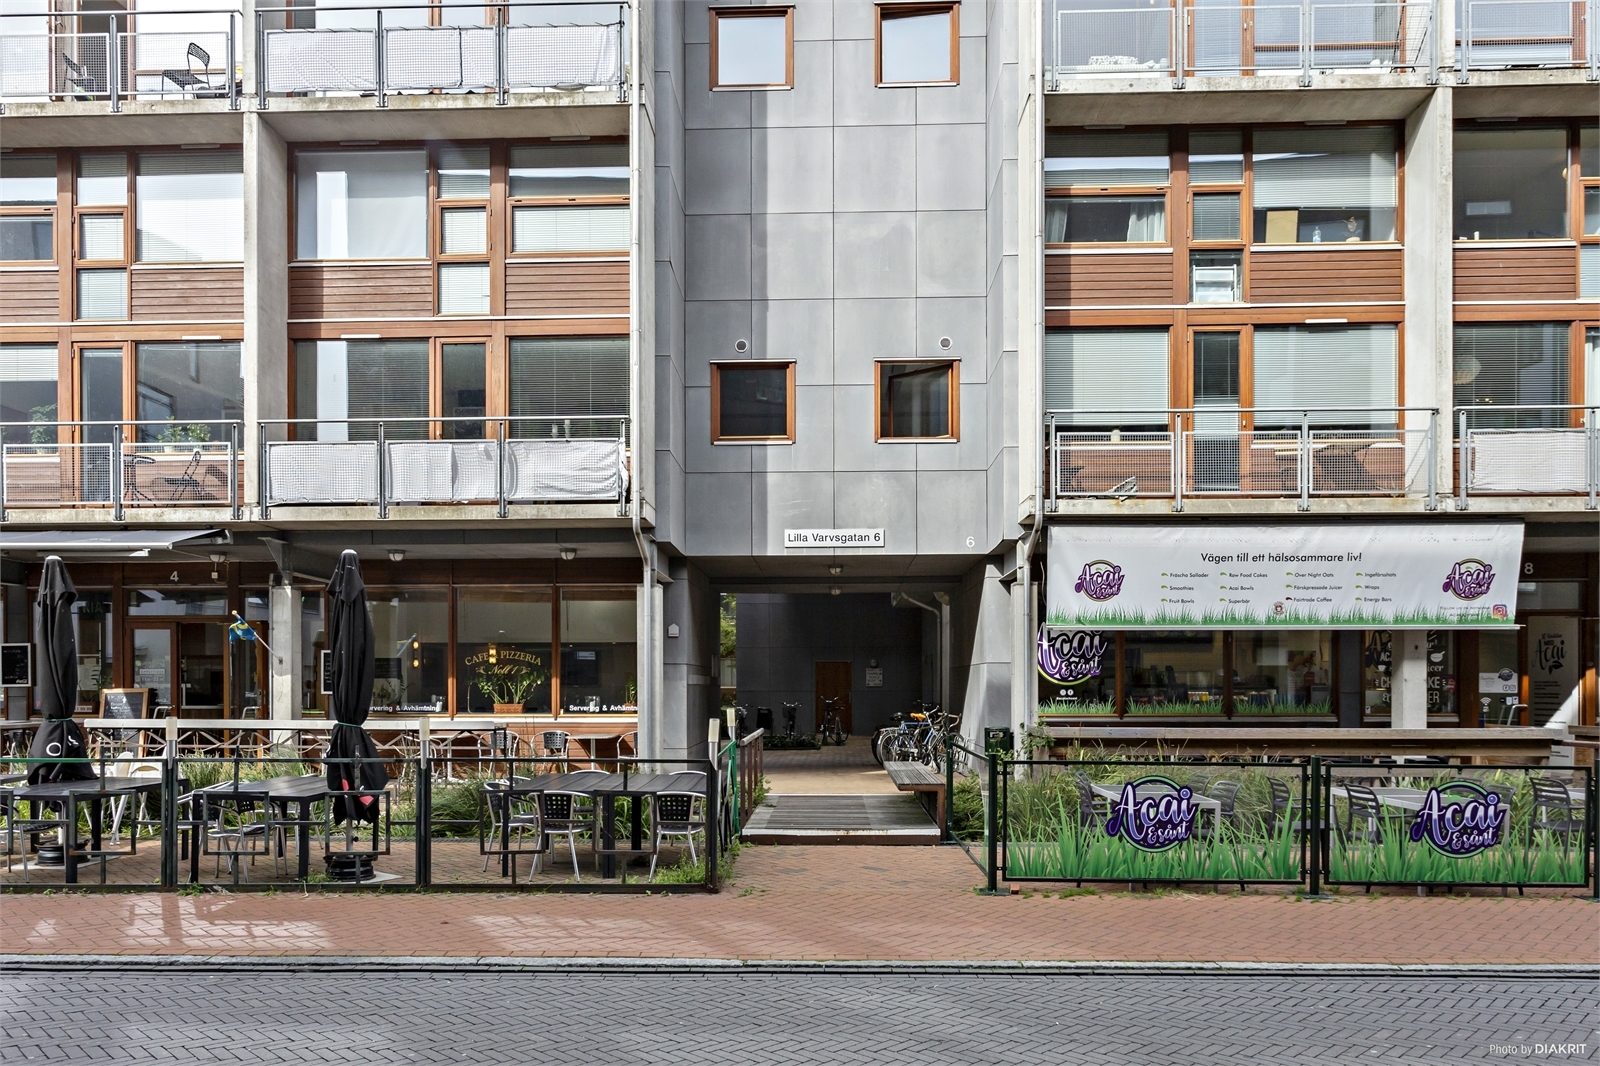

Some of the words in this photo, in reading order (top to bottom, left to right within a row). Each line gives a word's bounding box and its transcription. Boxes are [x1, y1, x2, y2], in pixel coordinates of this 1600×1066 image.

[788, 533, 808, 542] Lilla
[812, 533, 870, 544] Varvsgatan
[873, 532, 881, 542] 6
[966, 536, 975, 548] 6
[1201, 553, 1234, 564] Vägen
[1236, 552, 1249, 562] till
[1251, 552, 1265, 562] ett
[1268, 552, 1344, 562] hälsosammare
[1346, 552, 1362, 562] liv!
[1524, 562, 1534, 574] 8
[170, 570, 179, 582] 4
[1075, 563, 1125, 595] Acai
[1443, 562, 1496, 594] Acai
[500, 650, 542, 666] PIZZERIA
[1380, 652, 1392, 662] AC
[1061, 660, 1071, 678] &
[1071, 656, 1102, 676] sånt
[1427, 663, 1444, 673] icer
[370, 705, 393, 713] rvering
[1109, 784, 1196, 840] Acai
[1412, 789, 1504, 846] Acai
[1147, 826, 1158, 844] &
[1157, 821, 1190, 843] sånt
[1451, 832, 1462, 850] &
[1462, 827, 1497, 849] sånt
